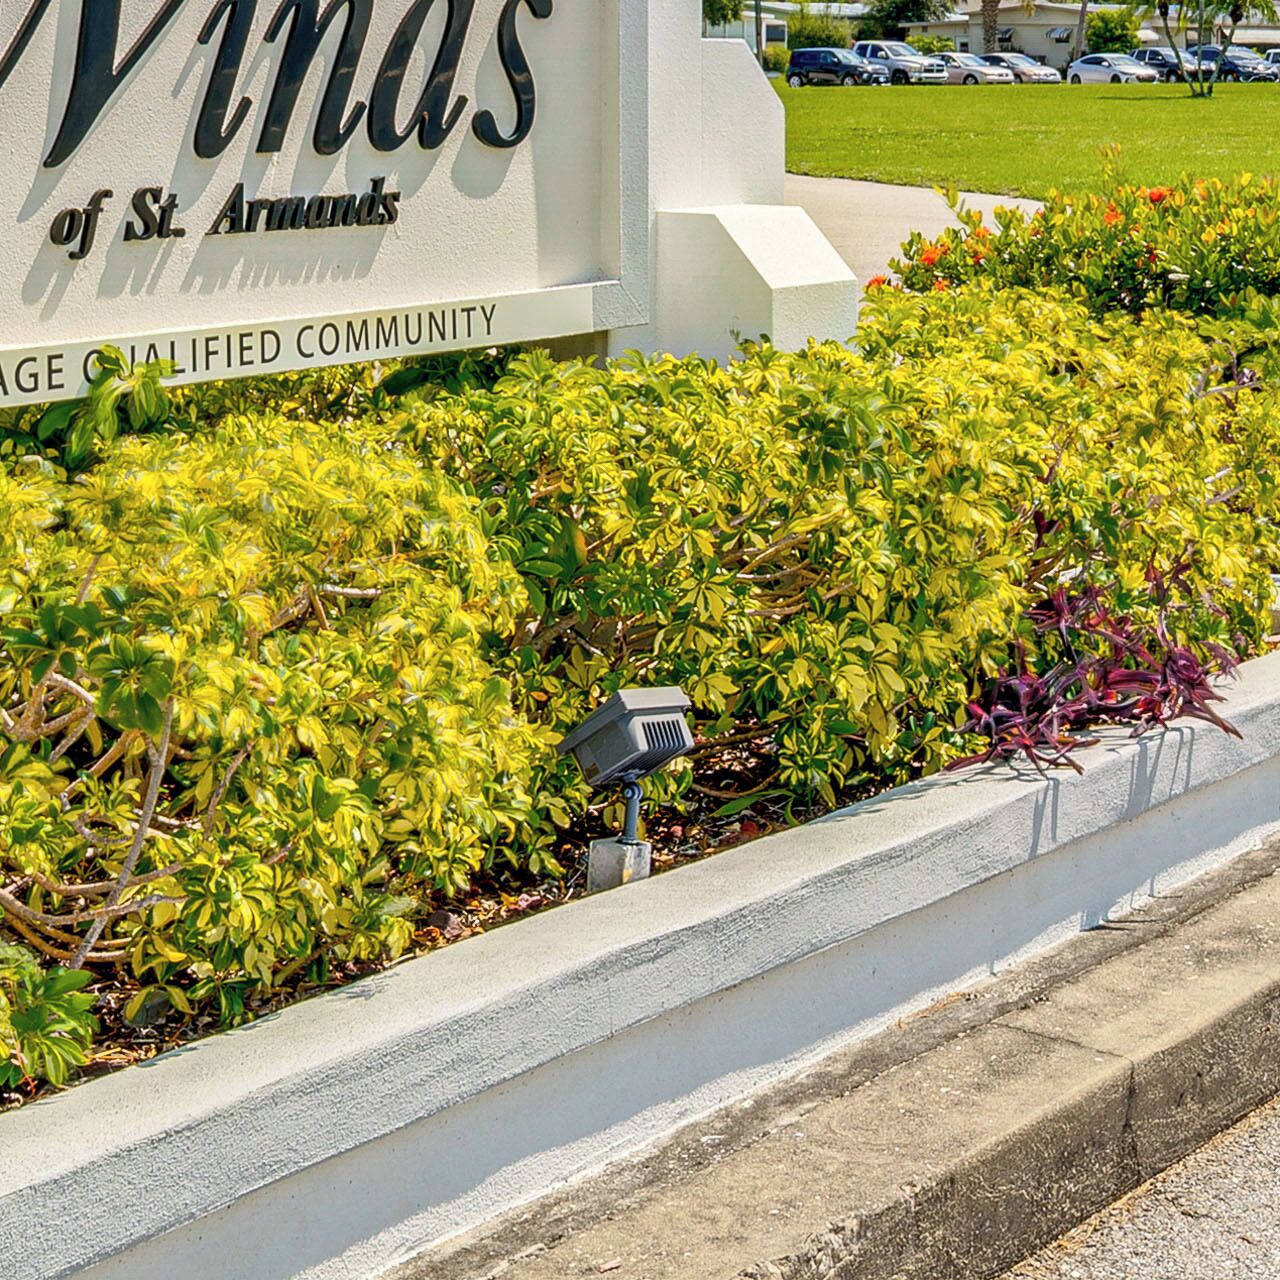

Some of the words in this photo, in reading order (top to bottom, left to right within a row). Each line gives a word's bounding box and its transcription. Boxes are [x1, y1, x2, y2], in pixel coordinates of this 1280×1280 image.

[49, 189, 113, 260] of
[123, 186, 186, 241] St.
[205, 176, 401, 236] Armands
[296, 303, 497, 359] COMMUNITY
